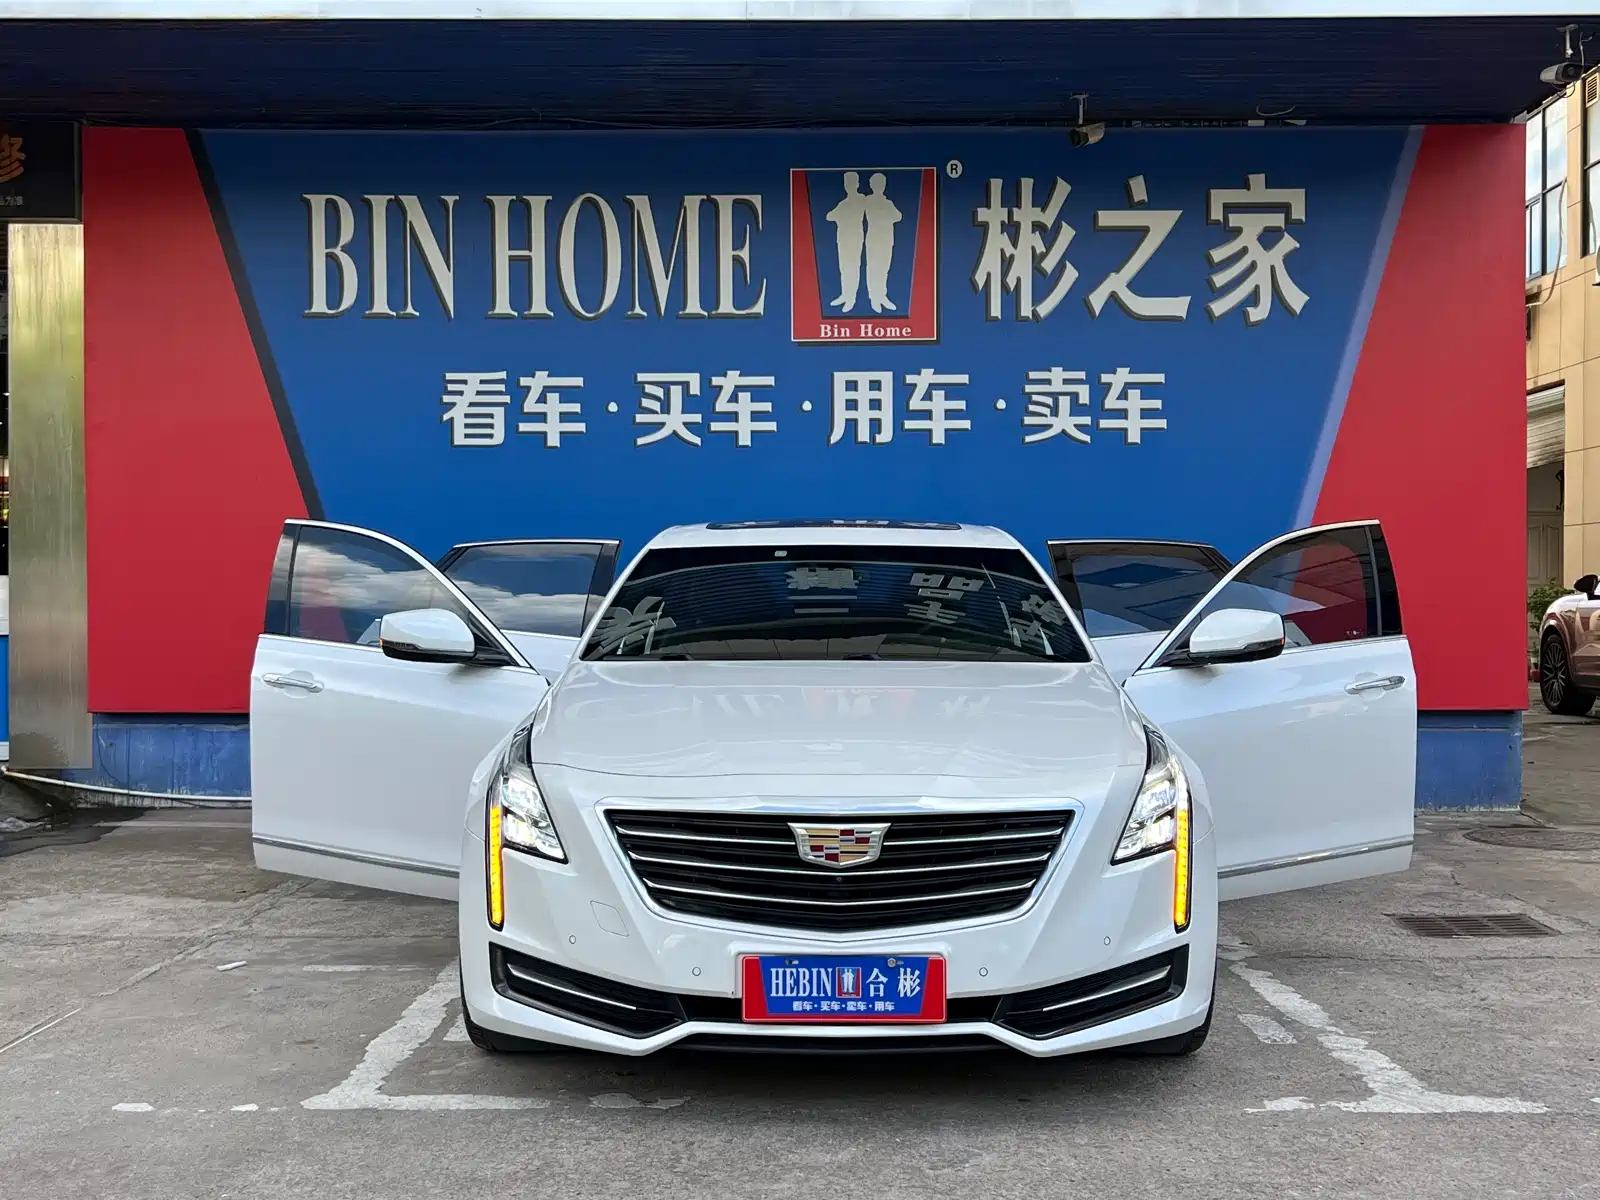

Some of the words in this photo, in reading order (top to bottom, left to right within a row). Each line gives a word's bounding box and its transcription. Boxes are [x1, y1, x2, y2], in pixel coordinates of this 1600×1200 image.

[301, 193, 459, 319] BIN
[484, 192, 767, 320] HOME
[970, 173, 1310, 326] 彬之家
[819, 323, 851, 338] Bin
[860, 322, 912, 338] Home
[770, 967, 833, 997] HEBIN
[865, 967, 921, 998] 合彬
